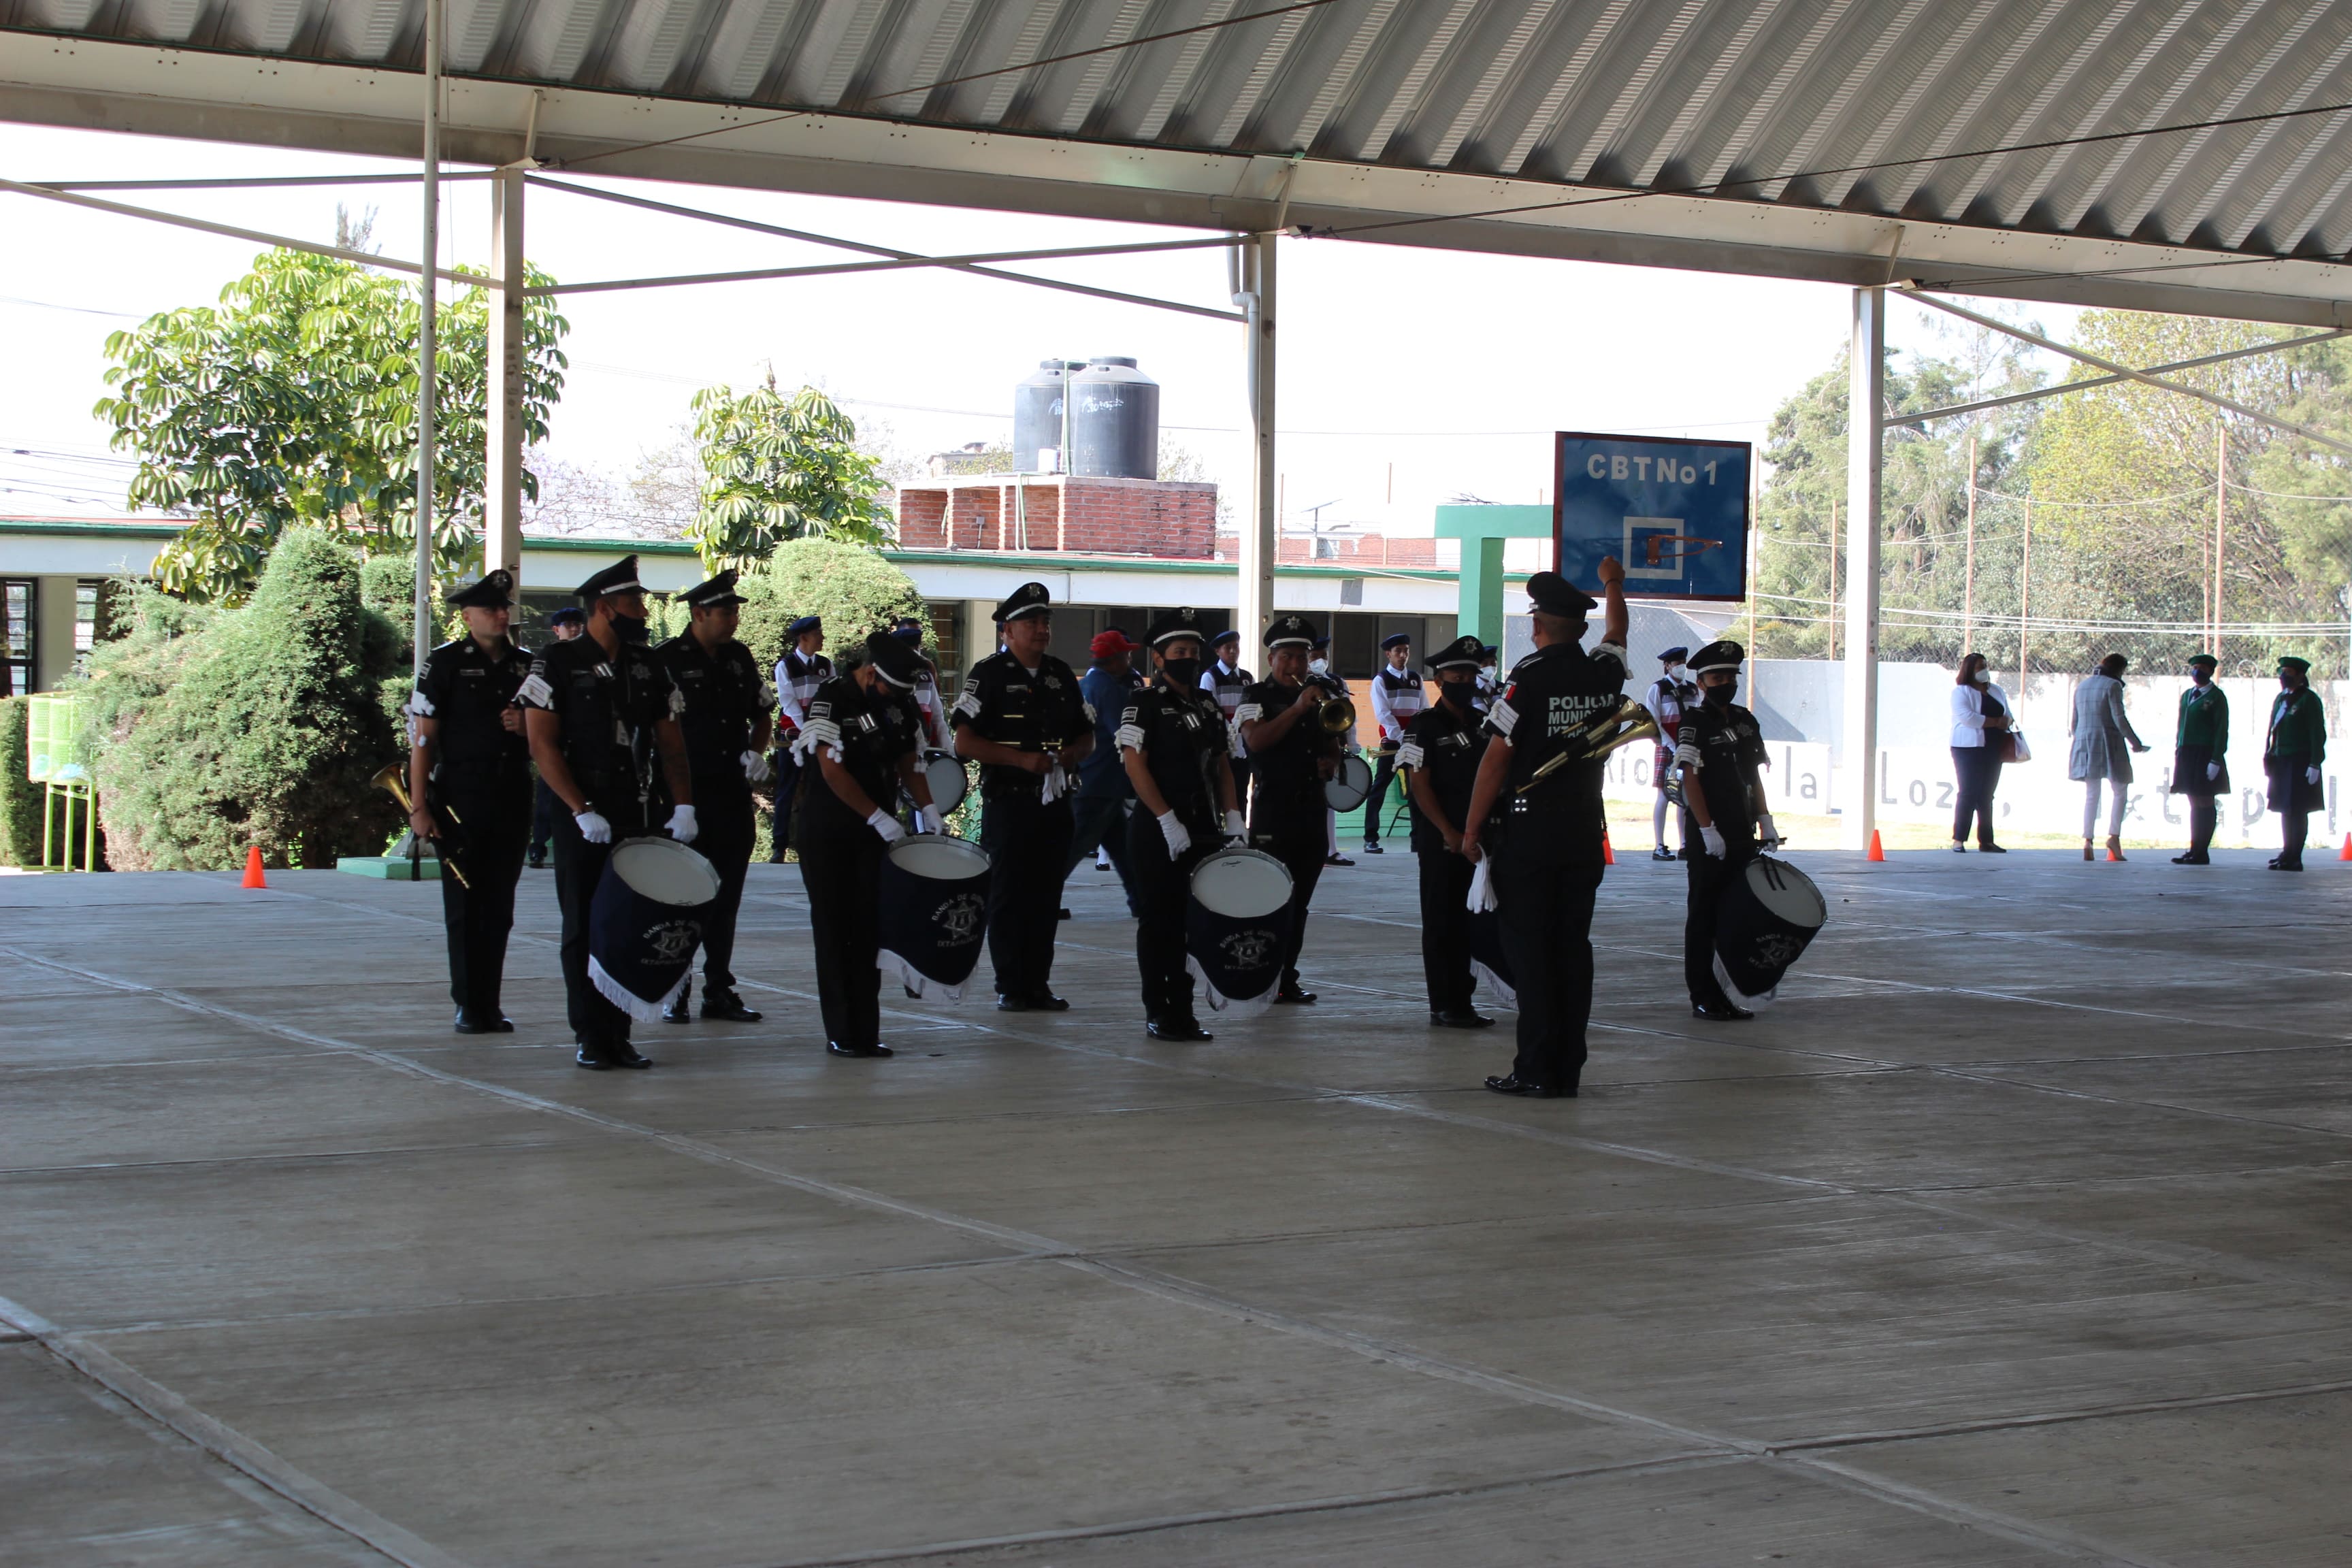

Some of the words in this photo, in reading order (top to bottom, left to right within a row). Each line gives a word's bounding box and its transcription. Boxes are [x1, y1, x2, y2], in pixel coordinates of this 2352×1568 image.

[1786, 746, 1817, 800] la
[931, 899, 954, 921] BANDA
[642, 921, 671, 939] BANDA
